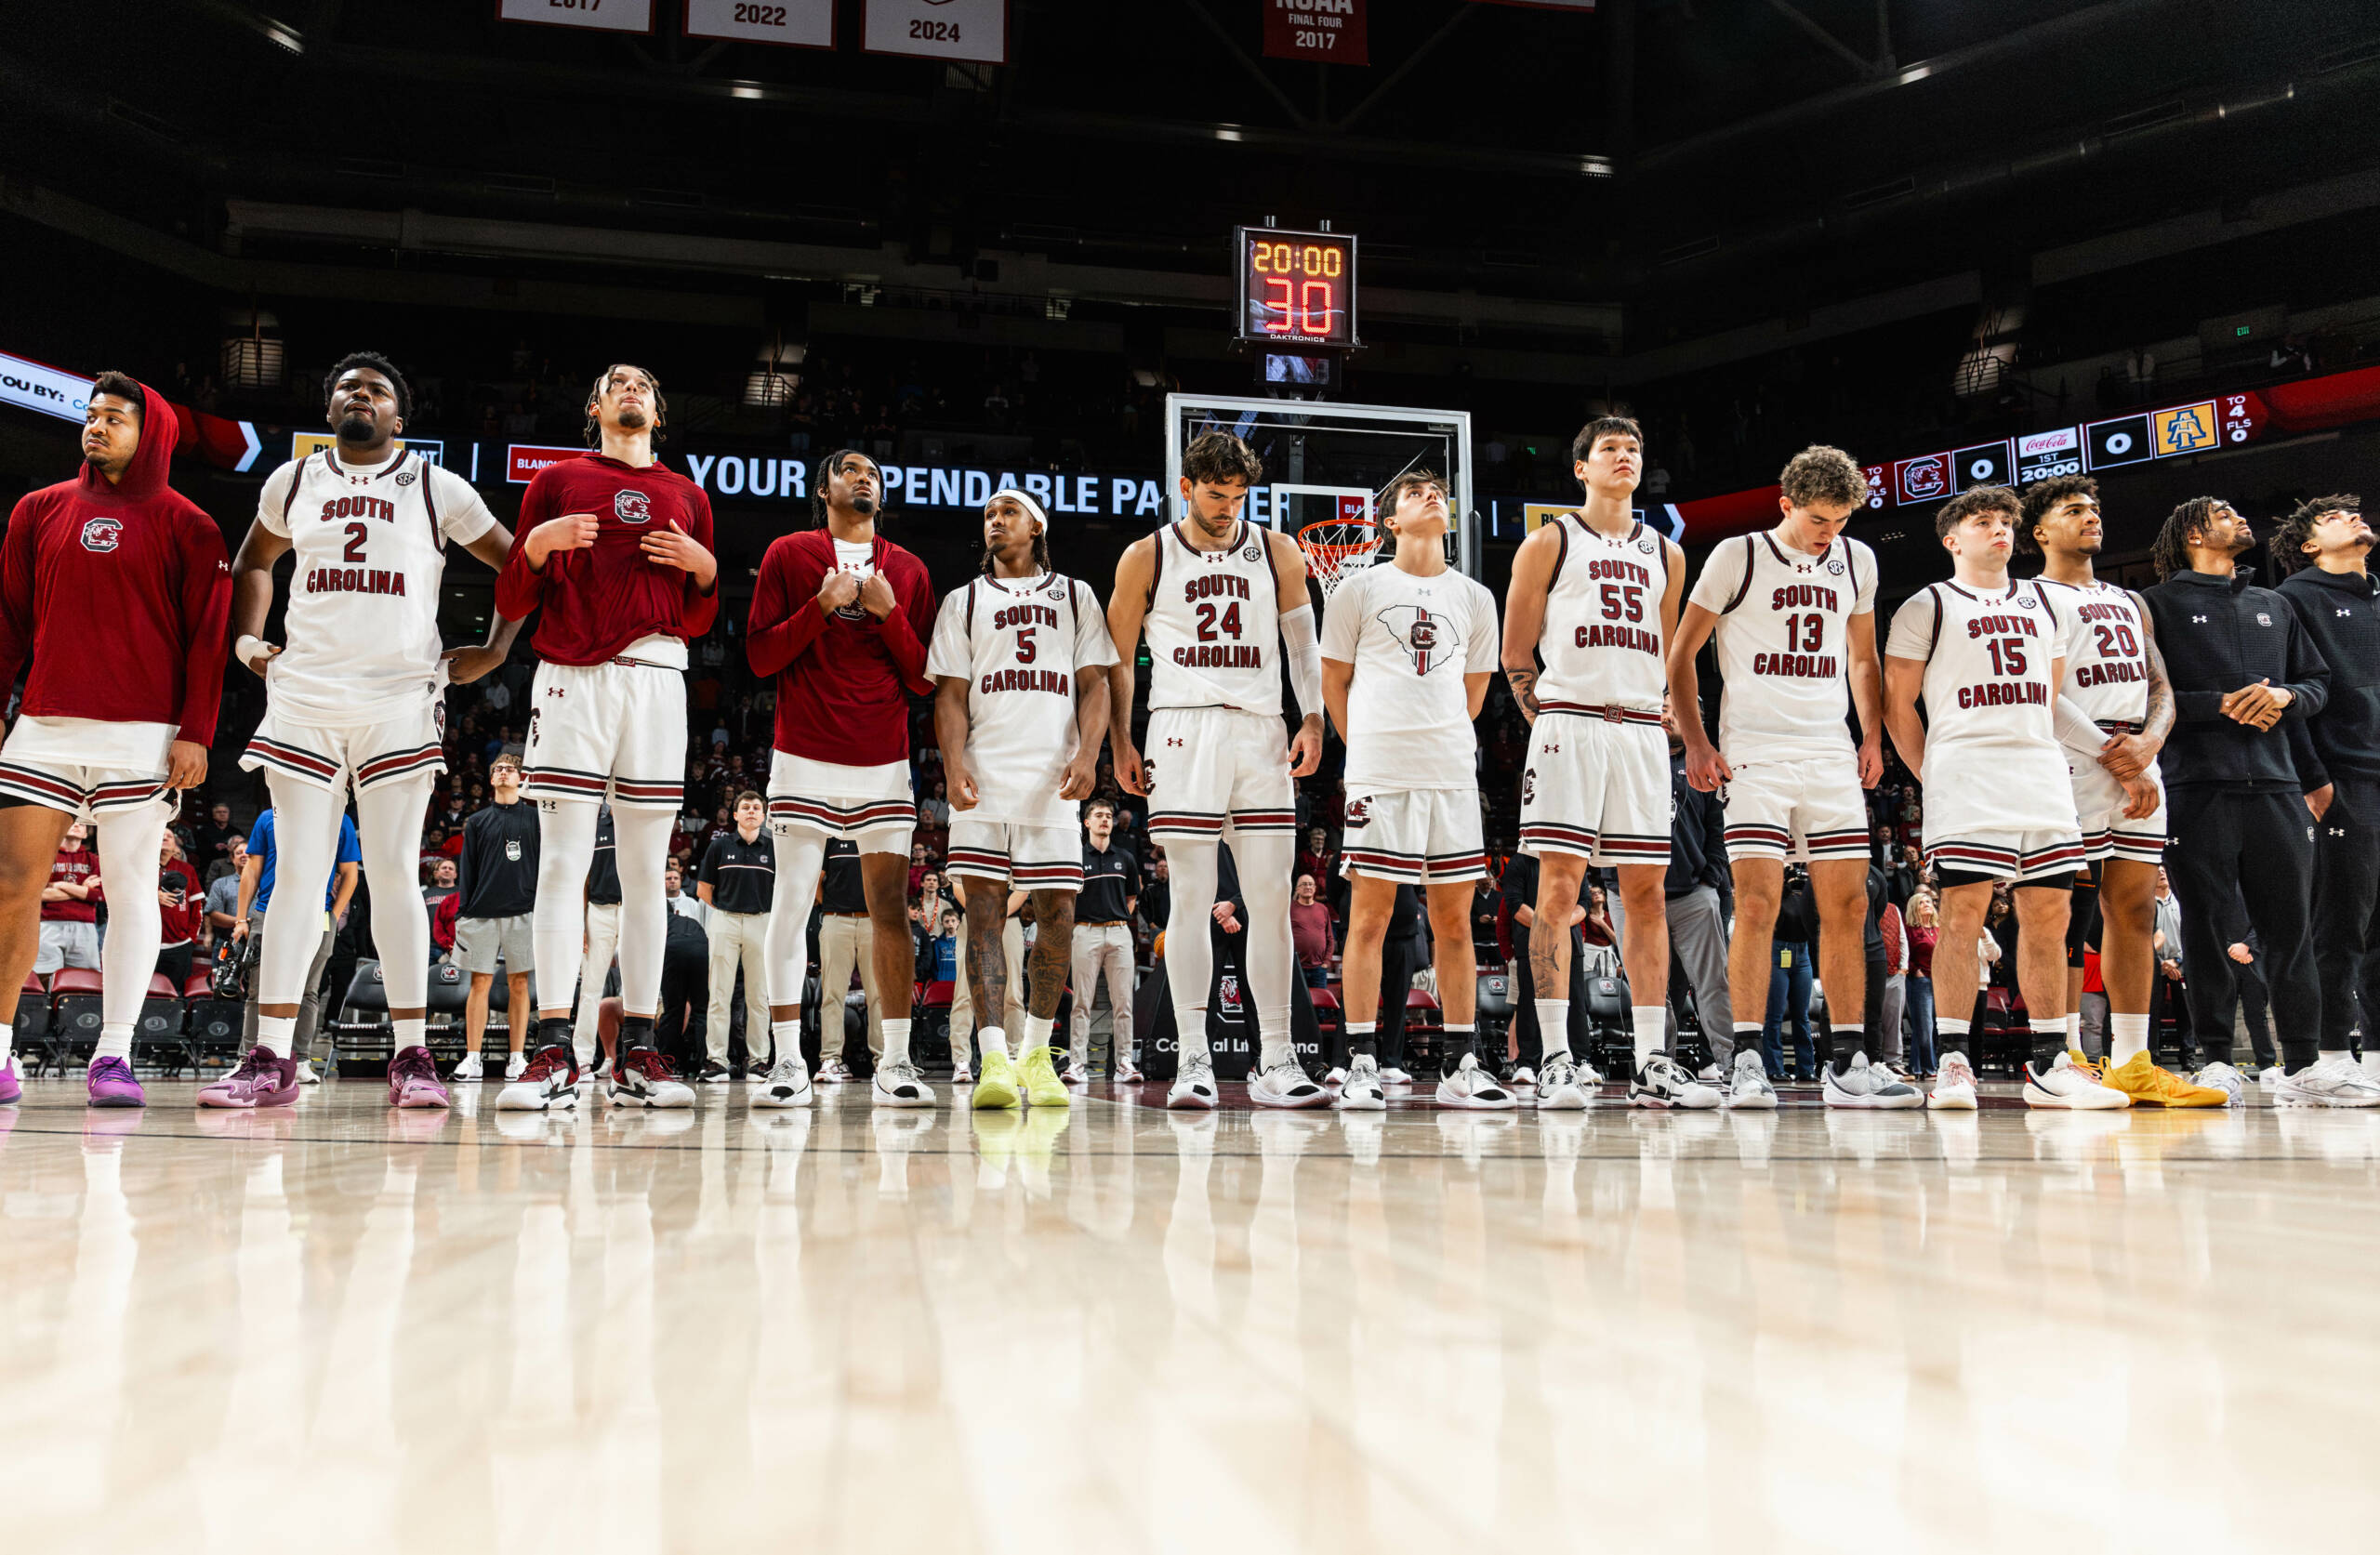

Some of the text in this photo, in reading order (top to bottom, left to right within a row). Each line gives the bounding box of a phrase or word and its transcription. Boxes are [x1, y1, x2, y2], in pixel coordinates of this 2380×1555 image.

[734, 3, 787, 26] 2022
[1289, 13, 1342, 28] FINAL FOUR
[909, 20, 960, 43] 2024
[1296, 31, 1336, 49] 2017
[1254, 242, 1341, 277] 20:00
[1265, 277, 1331, 334] 30
[1270, 334, 1325, 343] DAKTRONICS
[0, 374, 30, 391] OU
[33, 384, 65, 402] BY:
[2227, 395, 2246, 405] TO
[2228, 405, 2245, 416] 4
[2227, 418, 2252, 430] FLS
[2231, 429, 2248, 442] 0
[2106, 432, 2132, 455] 0
[1971, 459, 1993, 480] 0
[2039, 453, 2058, 464] 1ST
[686, 454, 806, 498] YOUR
[1867, 467, 1883, 476] TO
[1869, 475, 1882, 486] 4
[2021, 461, 2080, 482] 20:00
[1866, 488, 1887, 499] FLS
[1870, 497, 1884, 509] 0
[321, 496, 394, 523] SOUTH
[344, 522, 368, 562] 2
[307, 569, 405, 597] CAROLINA
[1589, 560, 1650, 589] SOUTH
[1185, 573, 1250, 603] SOUTH
[1771, 585, 1837, 613] SOUTH
[1600, 584, 1643, 623] 55
[2078, 603, 2135, 625] SOUTH
[994, 604, 1057, 630] SOUTH
[1196, 601, 1242, 642] 24
[1967, 615, 2038, 639] SOUTH
[1575, 625, 1659, 657] CAROLINA
[1785, 613, 1823, 652] 13
[2094, 625, 2139, 658] 20
[1016, 627, 1036, 664] 5
[1173, 645, 1261, 668] CAROLINA
[1987, 638, 2027, 676] 15
[1753, 652, 1836, 679] CAROLINA
[981, 669, 1068, 696] CAROLINA
